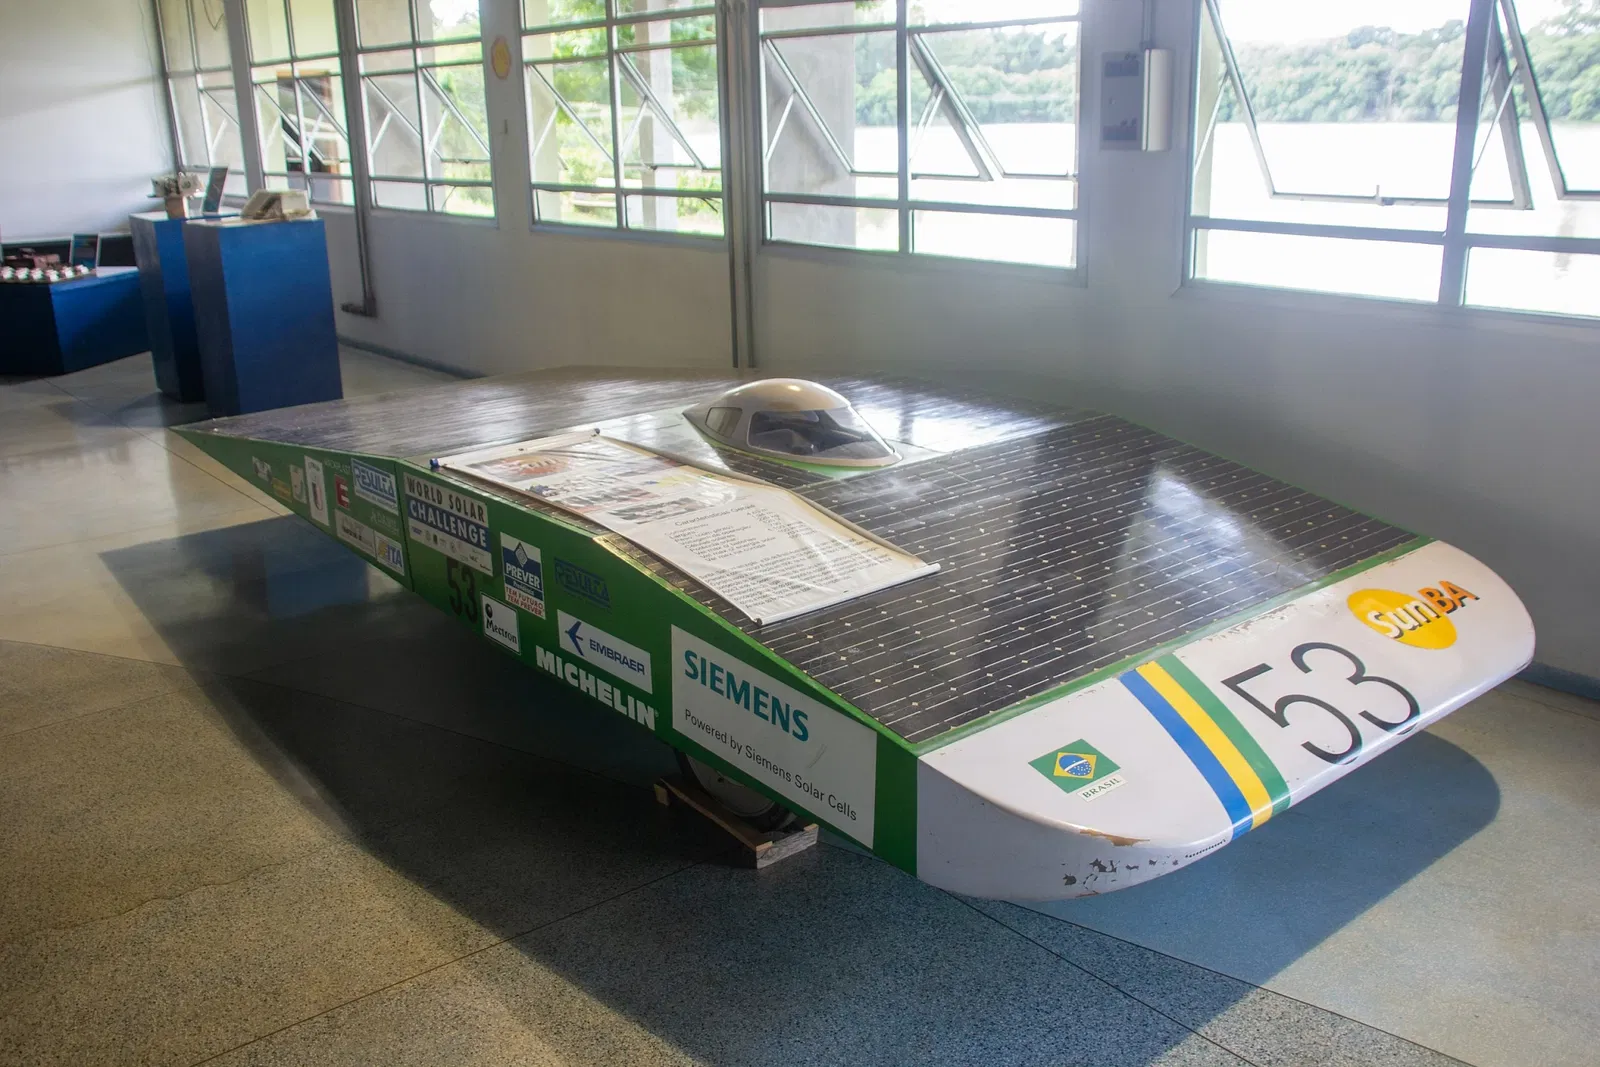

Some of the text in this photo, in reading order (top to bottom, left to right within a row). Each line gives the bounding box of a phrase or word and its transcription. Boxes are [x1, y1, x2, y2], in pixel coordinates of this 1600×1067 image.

[407, 477, 443, 505] WORLD
[449, 494, 485, 523] SOLAR
[410, 500, 487, 548] CHALLENGE
[387, 546, 403, 568] ITA
[506, 562, 541, 589] PREVER
[446, 555, 478, 625] 53
[486, 619, 517, 644] Mectron
[589, 638, 645, 675] EMBRAER
[684, 649, 809, 742] SIEMENS
[1221, 641, 1421, 766] 53
[685, 708, 857, 821] Powered by Siemens Solar Cells
[1082, 778, 1122, 798] BRASIL
